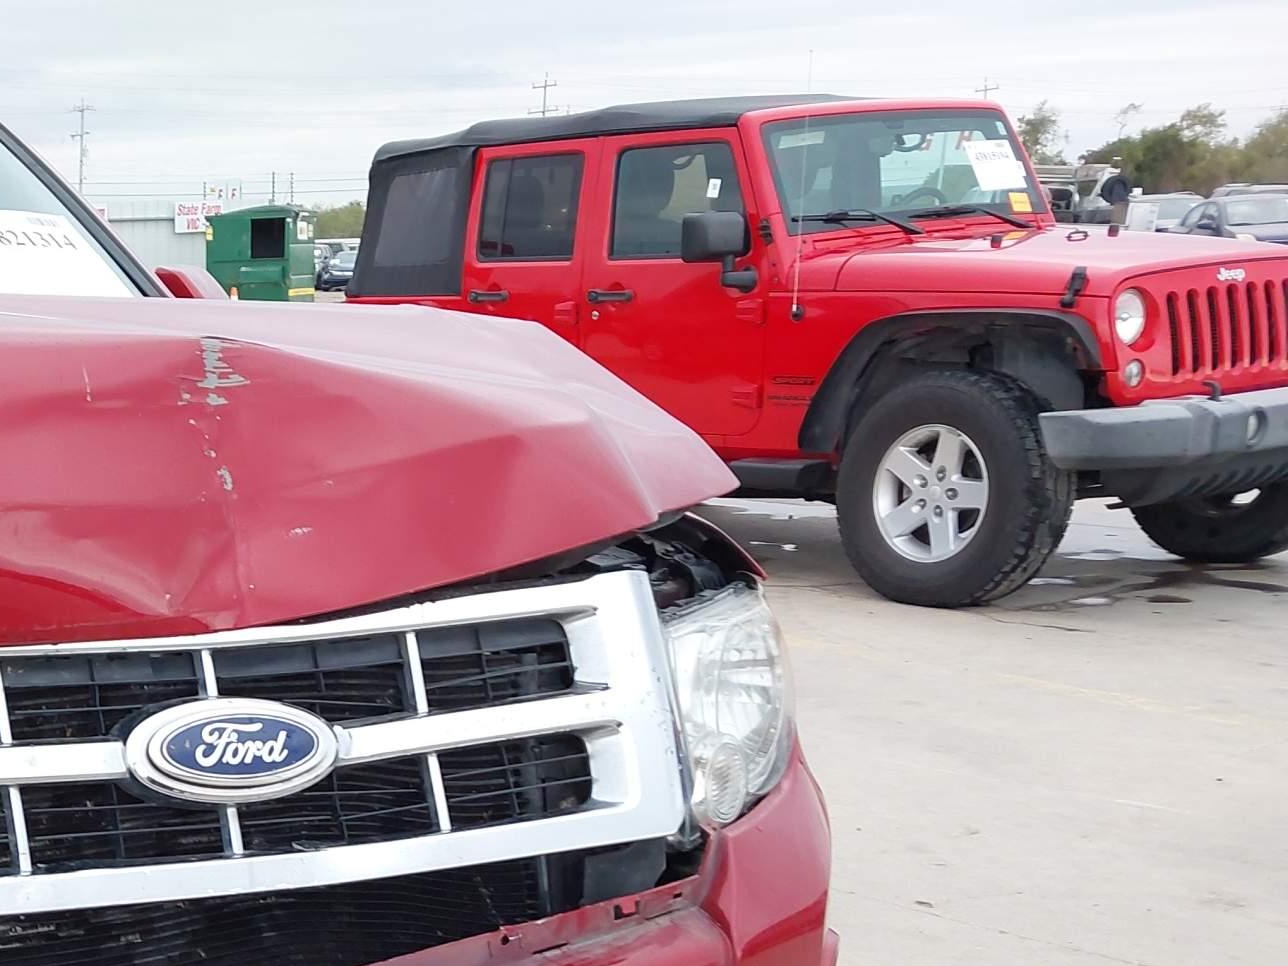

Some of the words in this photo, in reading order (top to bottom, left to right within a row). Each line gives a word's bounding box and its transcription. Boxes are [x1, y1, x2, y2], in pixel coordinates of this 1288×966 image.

[177, 204, 199, 217] State
[1216, 267, 1245, 282] Jeep
[194, 722, 289, 768] Ford
